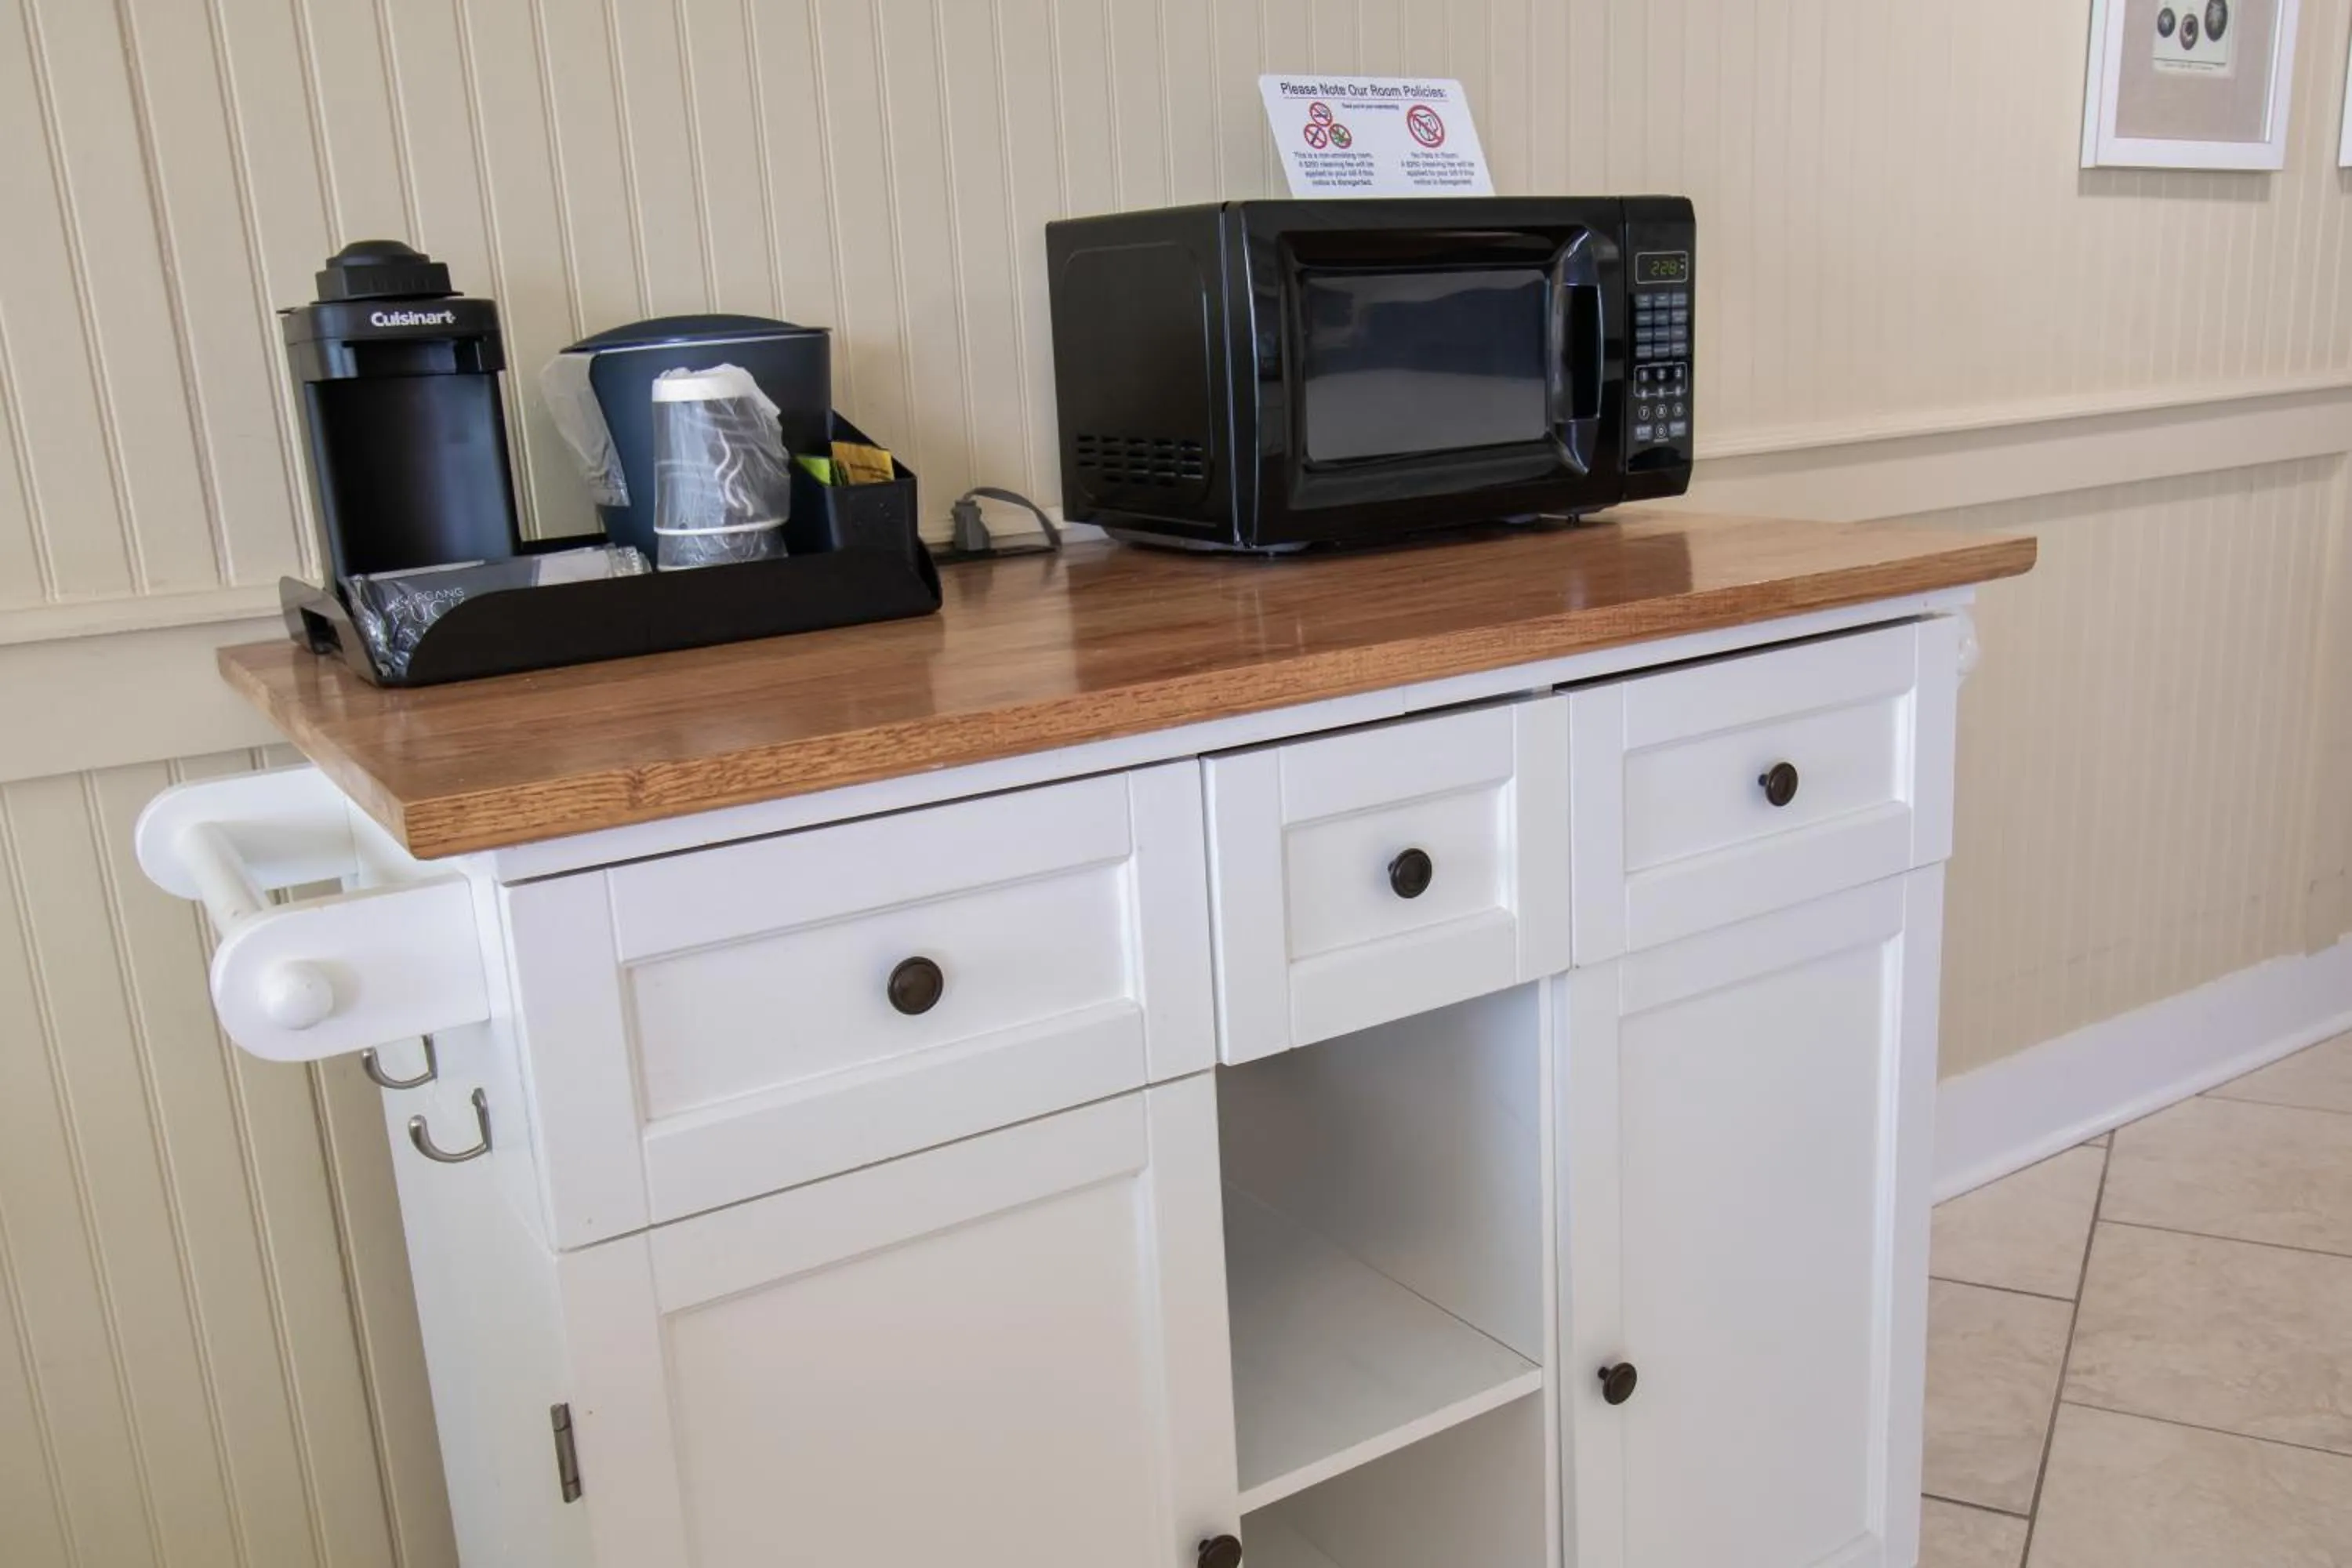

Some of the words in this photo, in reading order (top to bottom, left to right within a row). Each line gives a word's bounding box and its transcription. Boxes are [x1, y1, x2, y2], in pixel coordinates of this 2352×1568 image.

[1280, 82, 1317, 96] Please
[1319, 83, 1346, 96] Note
[1348, 84, 1367, 96] Our
[1370, 84, 1402, 97] Room
[1403, 85, 1447, 98] Policies:
[371, 310, 456, 327] Cuisinart
